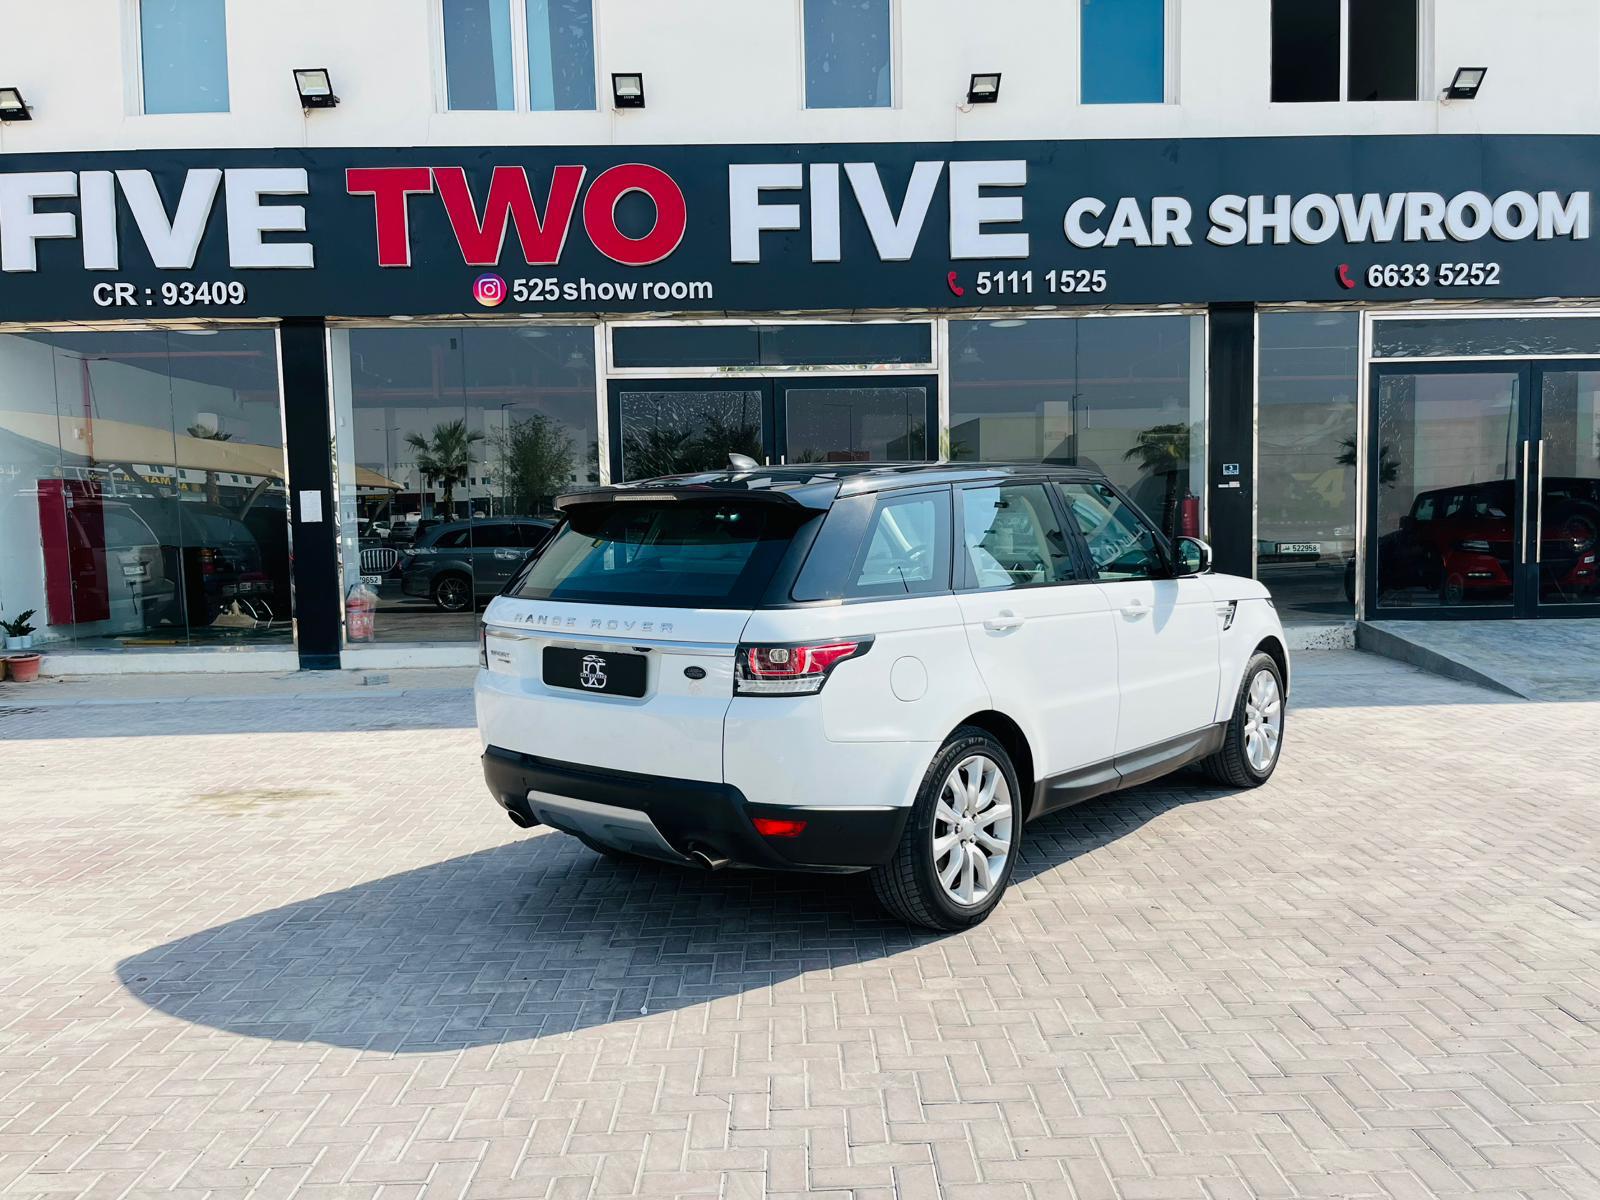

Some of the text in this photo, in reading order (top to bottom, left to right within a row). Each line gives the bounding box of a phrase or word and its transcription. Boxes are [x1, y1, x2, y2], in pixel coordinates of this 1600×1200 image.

[0, 160, 1589, 271] FIVE TWO FIVE CAR SHOWROOM
[977, 270, 1106, 294] 5111 1525
[1369, 263, 1499, 286] 6633 5252
[94, 283, 137, 306] CR
[162, 282, 245, 305] 93409
[1292, 544, 1318, 552] 522958
[360, 576, 378, 584] 9652
[514, 613, 674, 633] RANGE ROVER
